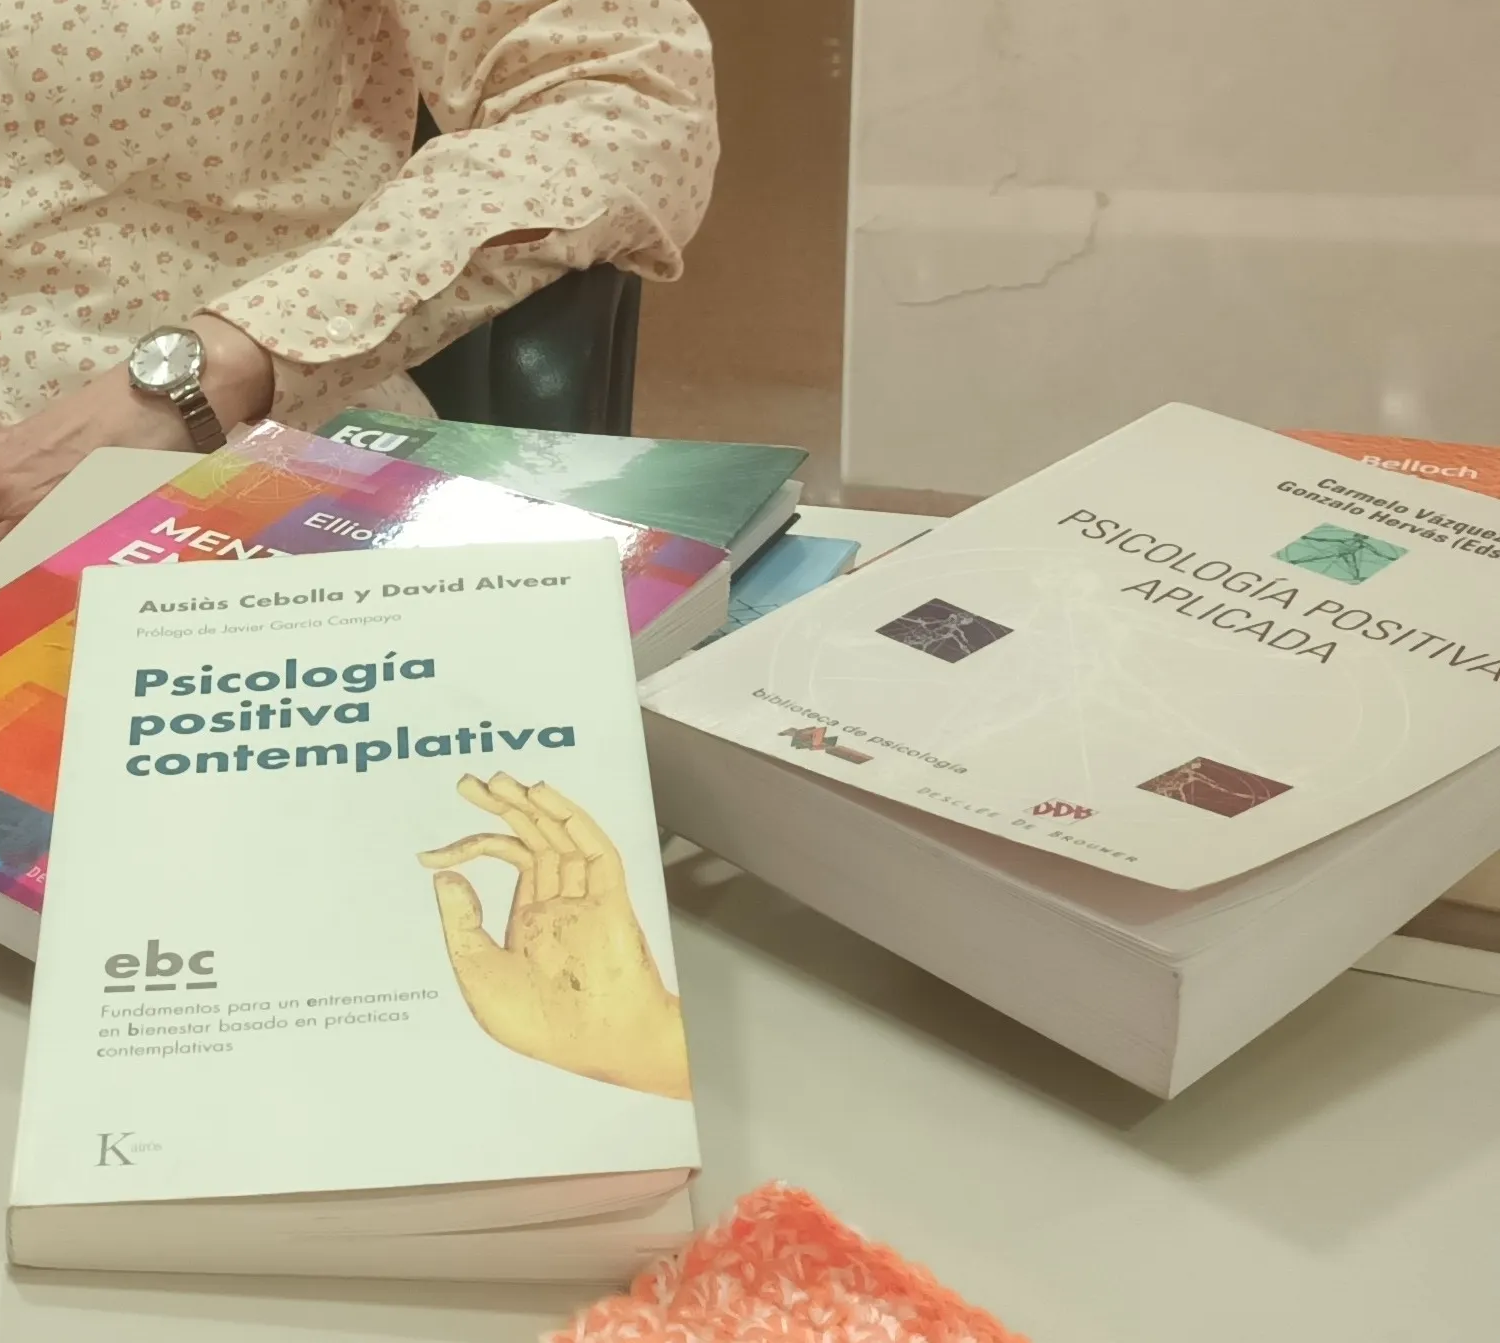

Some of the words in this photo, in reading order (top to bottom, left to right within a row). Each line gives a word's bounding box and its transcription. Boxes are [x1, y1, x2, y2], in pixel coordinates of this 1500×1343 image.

[329, 424, 411, 453] ECU
[1360, 454, 1479, 480] Belloch
[1276, 480, 1365, 515] Gonzalo
[1367, 511, 1449, 543] Hervás
[1317, 478, 1409, 514] Carmelo
[303, 512, 376, 542] Ellio
[139, 593, 229, 614] Ausiàs
[239, 587, 344, 609] Cebolla
[354, 587, 371, 605] y
[382, 576, 465, 598] David
[475, 572, 572, 592] Alvear
[1057, 508, 1300, 610] PSICOLOGÍA
[1303, 598, 1500, 683] POSITIVA
[136, 626, 194, 641] Prólogo
[197, 623, 217, 636] de
[220, 620, 266, 635] Javier
[270, 616, 324, 632] García
[327, 612, 403, 629] Campayo
[1120, 578, 1338, 664] APLICADA
[134, 651, 436, 697] Psicología
[128, 697, 371, 746] positiva
[751, 687, 841, 727] biblioteca
[841, 723, 868, 739] de
[867, 732, 968, 776] psicología
[125, 721, 576, 776] contemplativa
[1011, 818, 1037, 831] DE
[1048, 830, 1138, 863] BROUWER
[103, 938, 216, 980] ebc
[98, 1025, 121, 1039] en
[127, 1020, 212, 1038] bienestar
[218, 1015, 289, 1034] basado
[294, 1015, 318, 1029] en
[323, 1009, 411, 1029] prácticas
[100, 1001, 221, 1019] Fundamentos
[227, 1000, 271, 1016] para
[278, 997, 301, 1010] un
[306, 987, 440, 1009] entrenamiento
[97, 1039, 234, 1060] contemplativas
